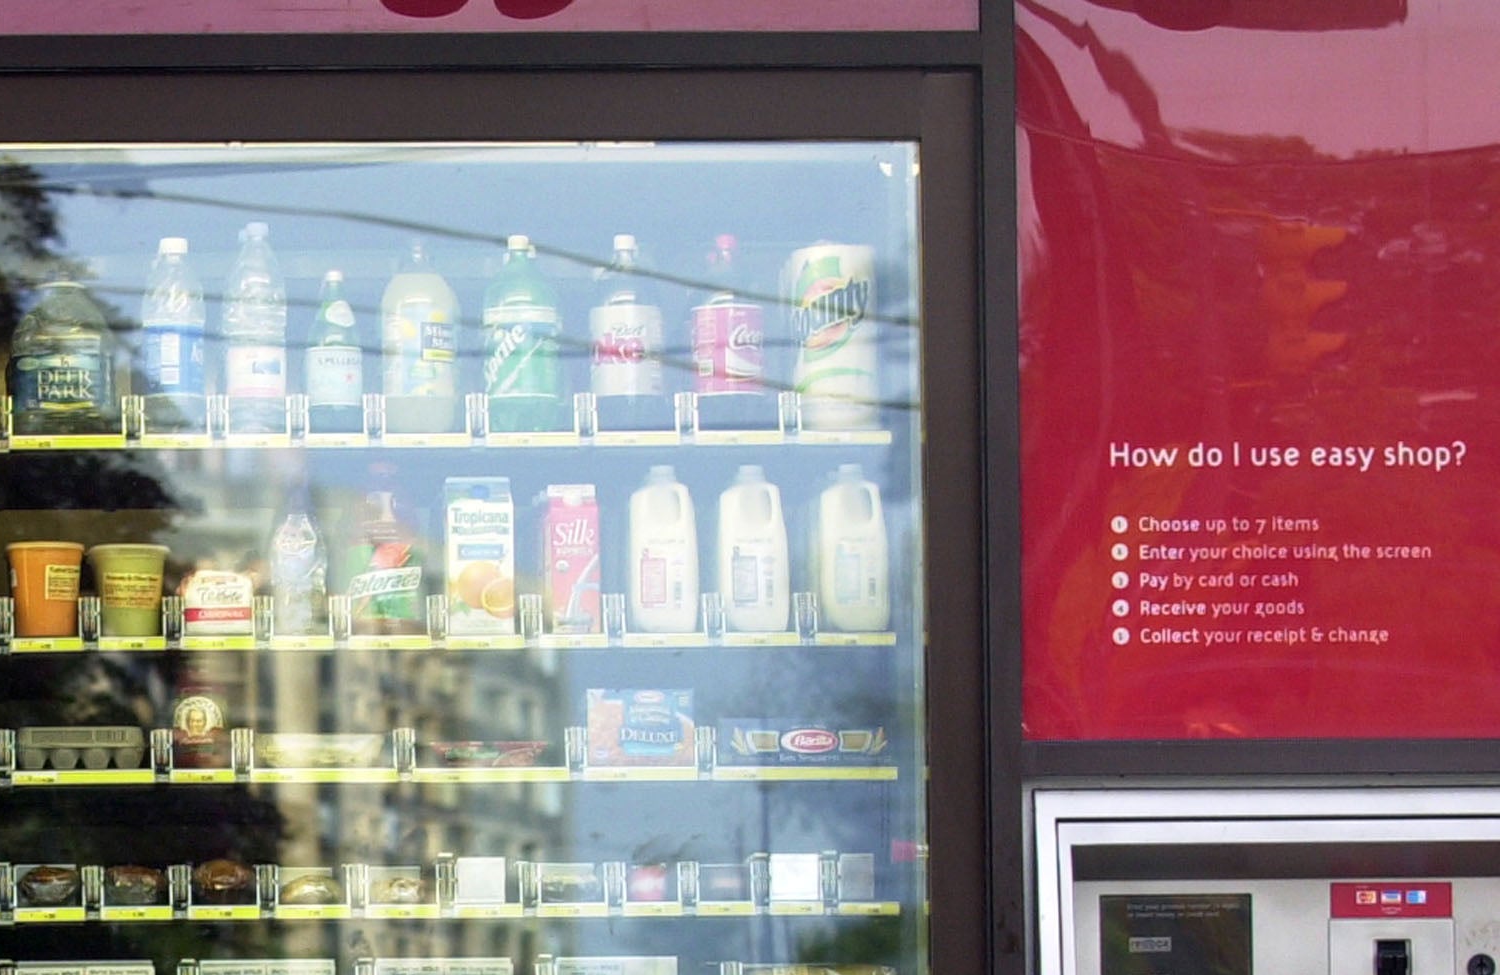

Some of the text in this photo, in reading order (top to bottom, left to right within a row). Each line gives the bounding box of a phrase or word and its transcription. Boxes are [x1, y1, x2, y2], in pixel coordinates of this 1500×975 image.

[37, 369, 93, 385] DEER
[38, 384, 94, 400] PARK
[1109, 439, 1467, 472] How do I use easy shop?
[451, 507, 509, 526] Tropicana
[1138, 515, 1201, 533] Choose
[1205, 519, 1227, 536] up
[1232, 515, 1250, 532] to
[1255, 518, 1267, 535] 7
[1271, 516, 1320, 532] items
[552, 519, 596, 546] Silk
[1139, 544, 1185, 560] Enter
[1189, 548, 1228, 563] your
[1232, 544, 1288, 559] choice
[1292, 543, 1340, 562] using
[1342, 543, 1372, 559] the
[1376, 545, 1432, 559] screen
[1139, 572, 1169, 591] Pay
[1172, 572, 1194, 591] by
[1198, 571, 1234, 588] card
[1239, 575, 1257, 588] or
[1261, 571, 1299, 588] cash
[1139, 600, 1207, 616] Receive
[1211, 603, 1250, 619] your
[1254, 600, 1305, 619] goods
[1139, 628, 1199, 644] Collect
[1203, 630, 1242, 648] your
[1246, 627, 1306, 647] receipt
[1310, 626, 1324, 643] &
[1328, 626, 1390, 646] change
